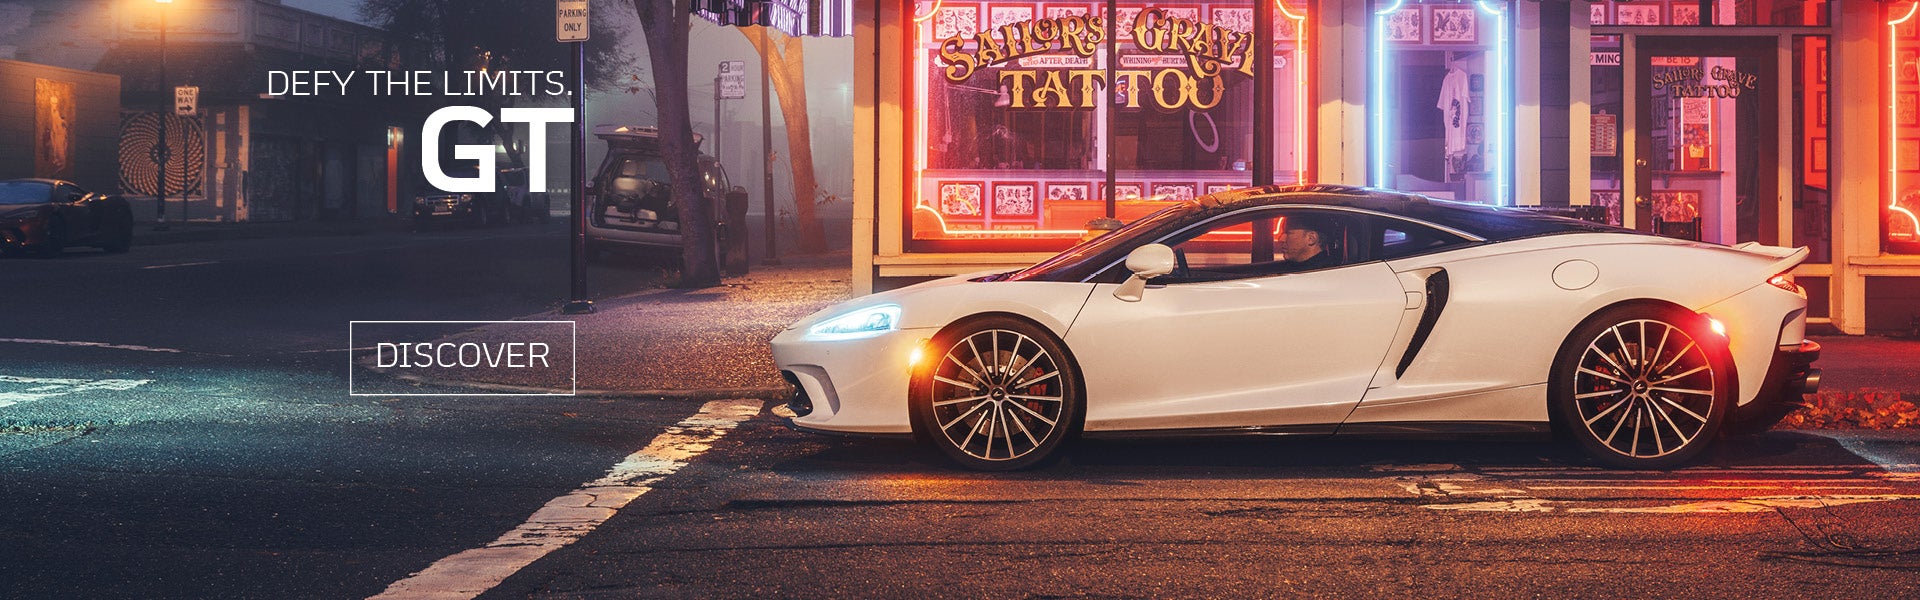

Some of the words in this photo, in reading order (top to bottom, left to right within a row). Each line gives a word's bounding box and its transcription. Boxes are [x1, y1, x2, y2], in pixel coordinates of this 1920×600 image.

[560, 9, 586, 17] PARKING
[564, 22, 582, 31] ONLY
[1040, 57, 1063, 65] AFTER
[1064, 57, 1089, 65] DEATH
[1123, 56, 1152, 65] WHINING
[1711, 65, 1757, 89] GRAVE
[999, 68, 1226, 112] TATTOO
[1672, 84, 1741, 98] TATTOO
